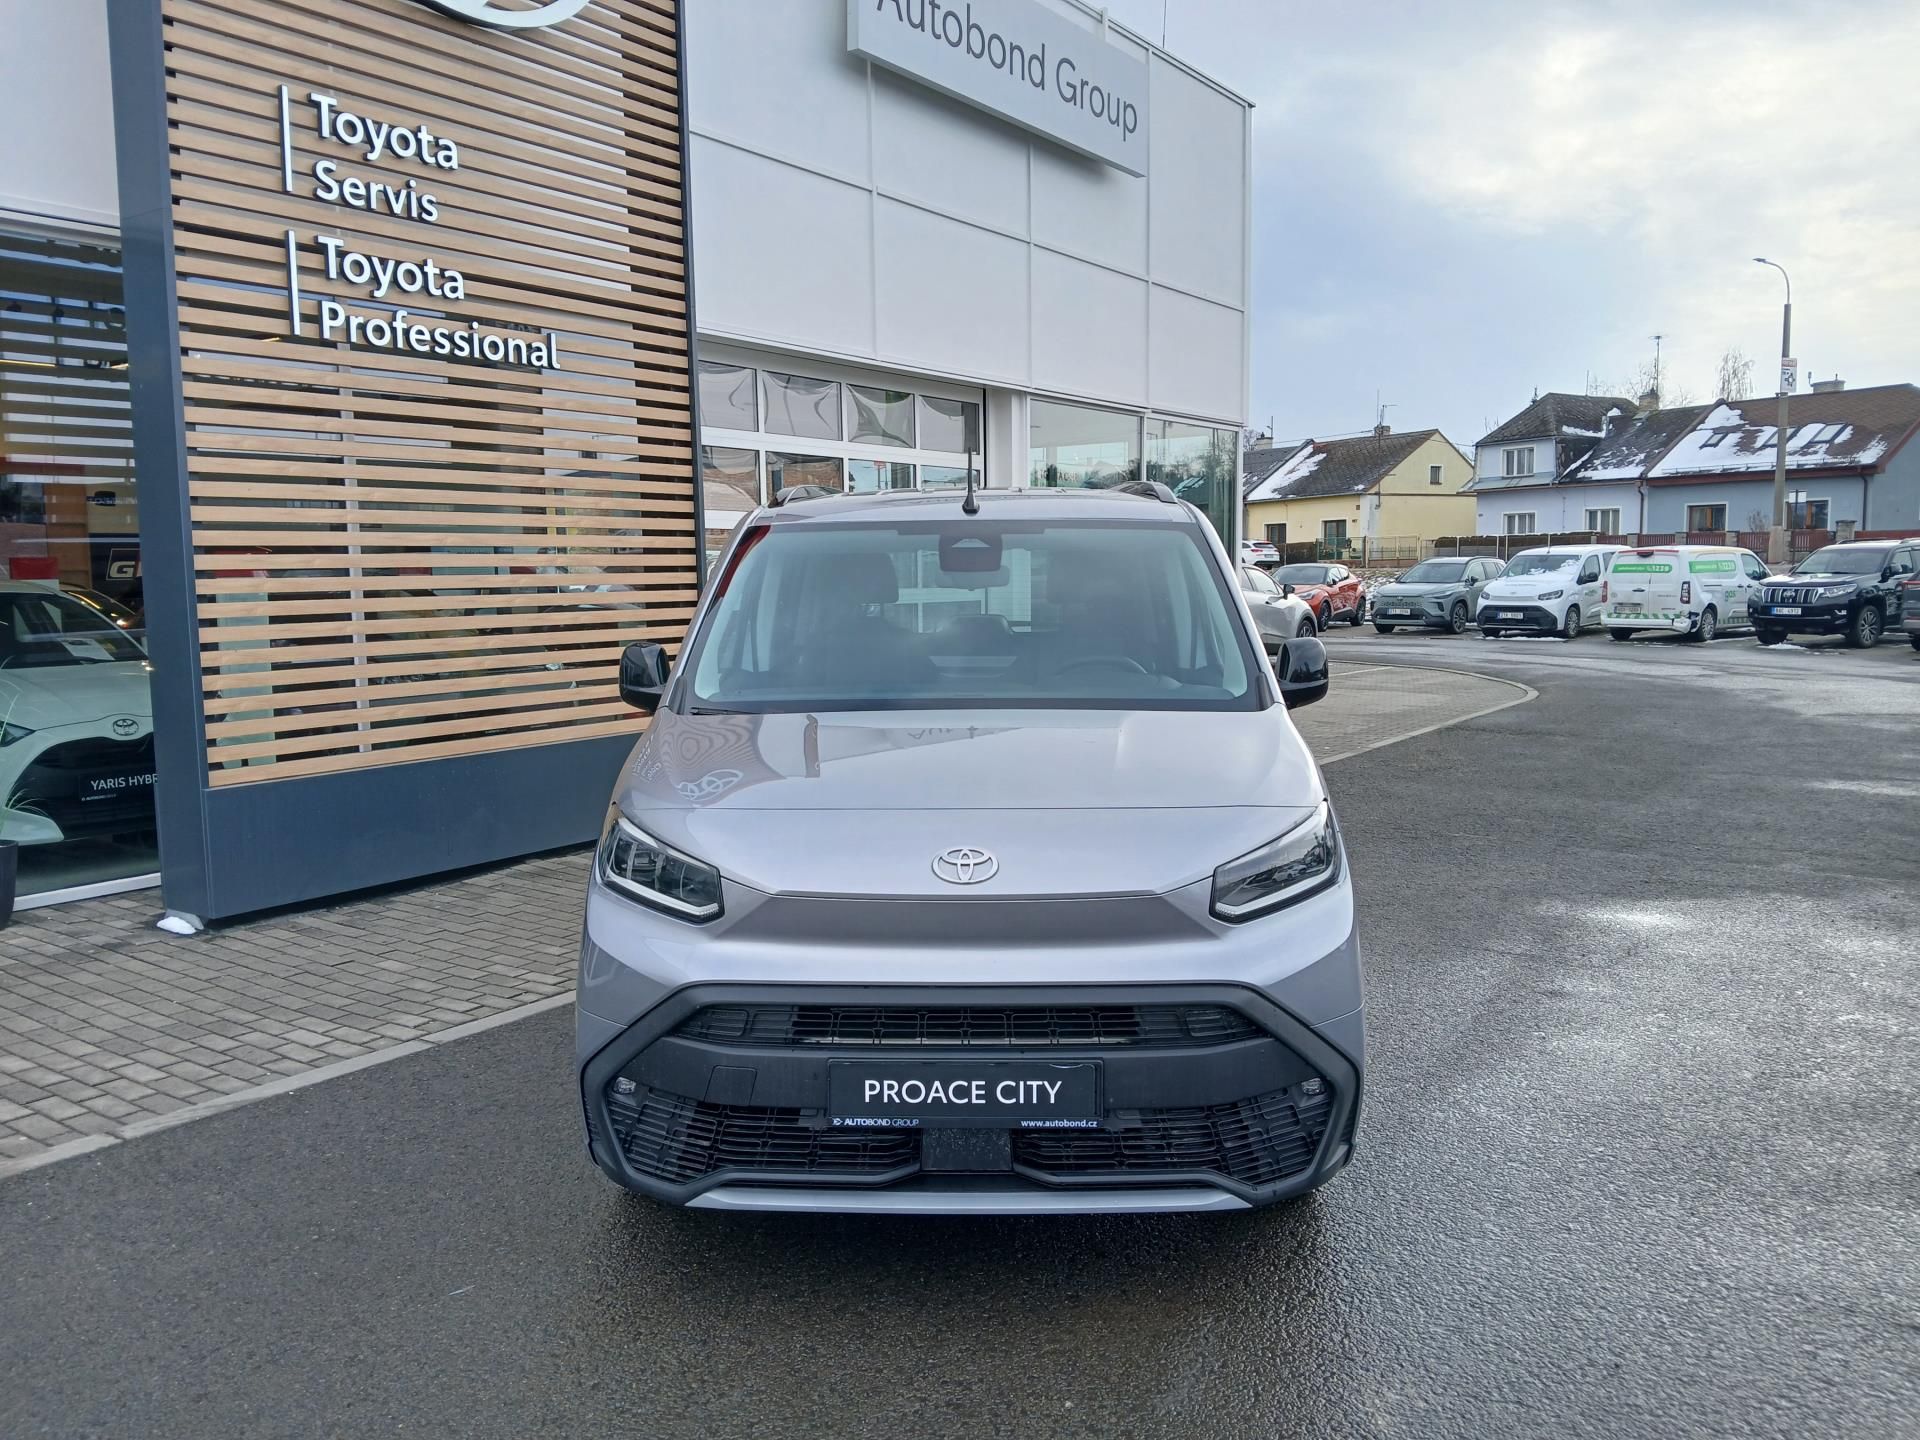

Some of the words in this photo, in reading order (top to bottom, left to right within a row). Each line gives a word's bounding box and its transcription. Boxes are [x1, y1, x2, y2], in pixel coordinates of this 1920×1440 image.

[1055, 57, 1138, 141] Group
[307, 92, 459, 170] Toyota
[313, 160, 440, 222] Servis
[315, 235, 466, 300] Toyota
[319, 301, 561, 370] Professional
[91, 777, 126, 790] YARIS
[844, 1118, 891, 1126] AUTOBOND
[892, 1118, 919, 1126] GROUP
[864, 1079, 986, 1104] PROACE
[996, 1080, 1062, 1104] CITY
[1020, 1119, 1098, 1128] www.autobond.cz
